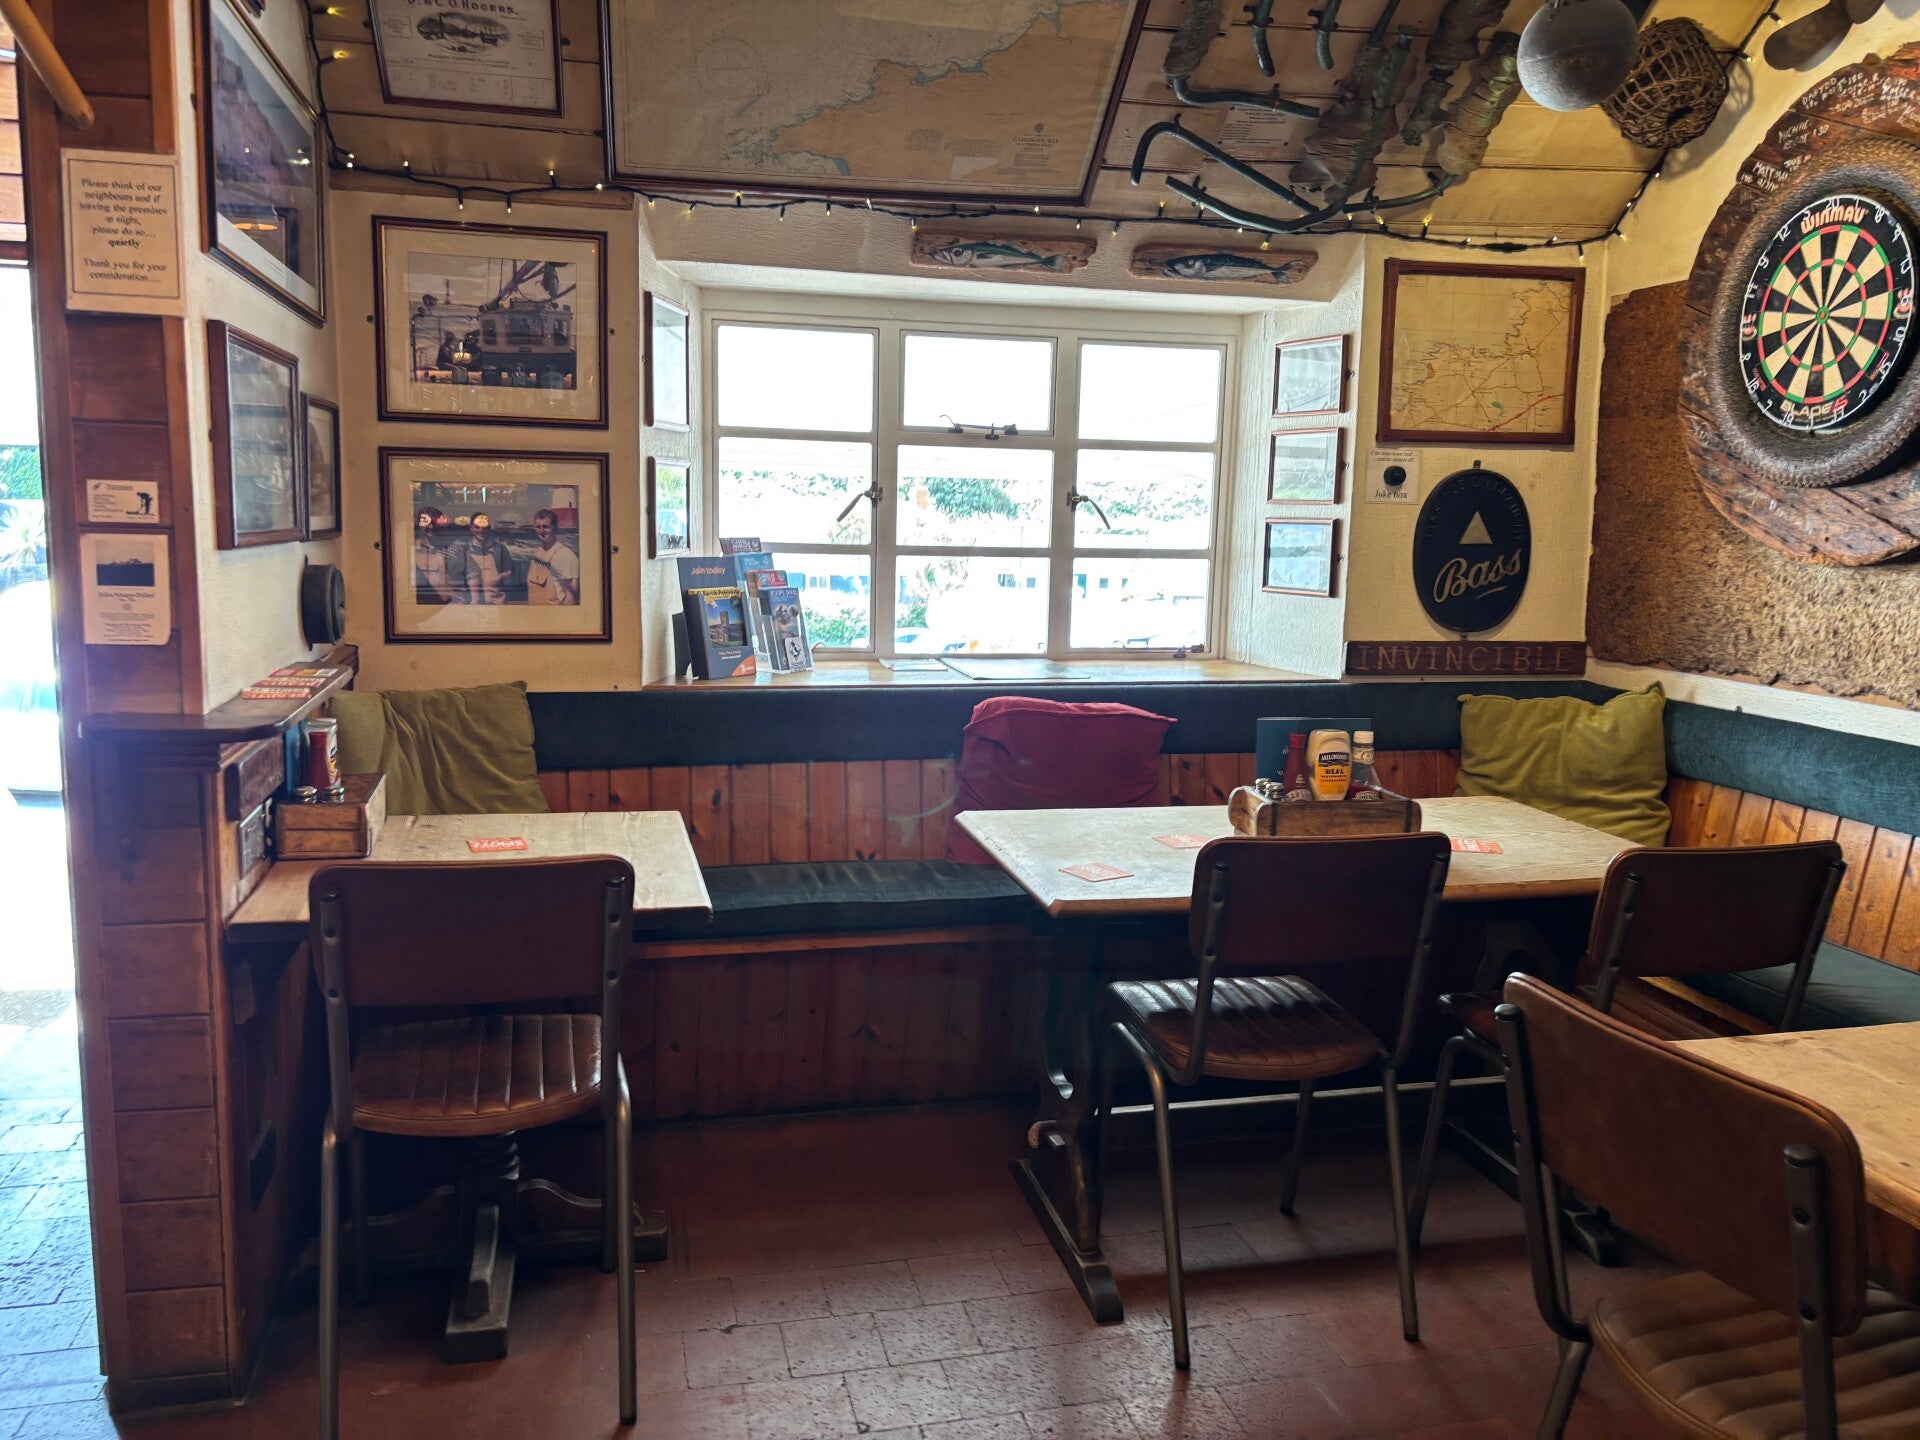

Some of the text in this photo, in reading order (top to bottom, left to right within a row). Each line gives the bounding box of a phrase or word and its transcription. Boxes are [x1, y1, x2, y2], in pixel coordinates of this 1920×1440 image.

[81, 178, 162, 192] Please think of our
[85, 191, 161, 203] neighbours and if
[1825, 197, 1840, 210] 20
[79, 201, 167, 215] leaving the premises
[92, 226, 119, 235] please
[122, 227, 133, 235] do
[1778, 225, 1791, 242] 12
[108, 238, 140, 249] quietly
[84, 258, 167, 272] Thank you for your
[1433, 548, 1521, 603] Bass
[1355, 645, 1572, 672] INVINCIBLE
